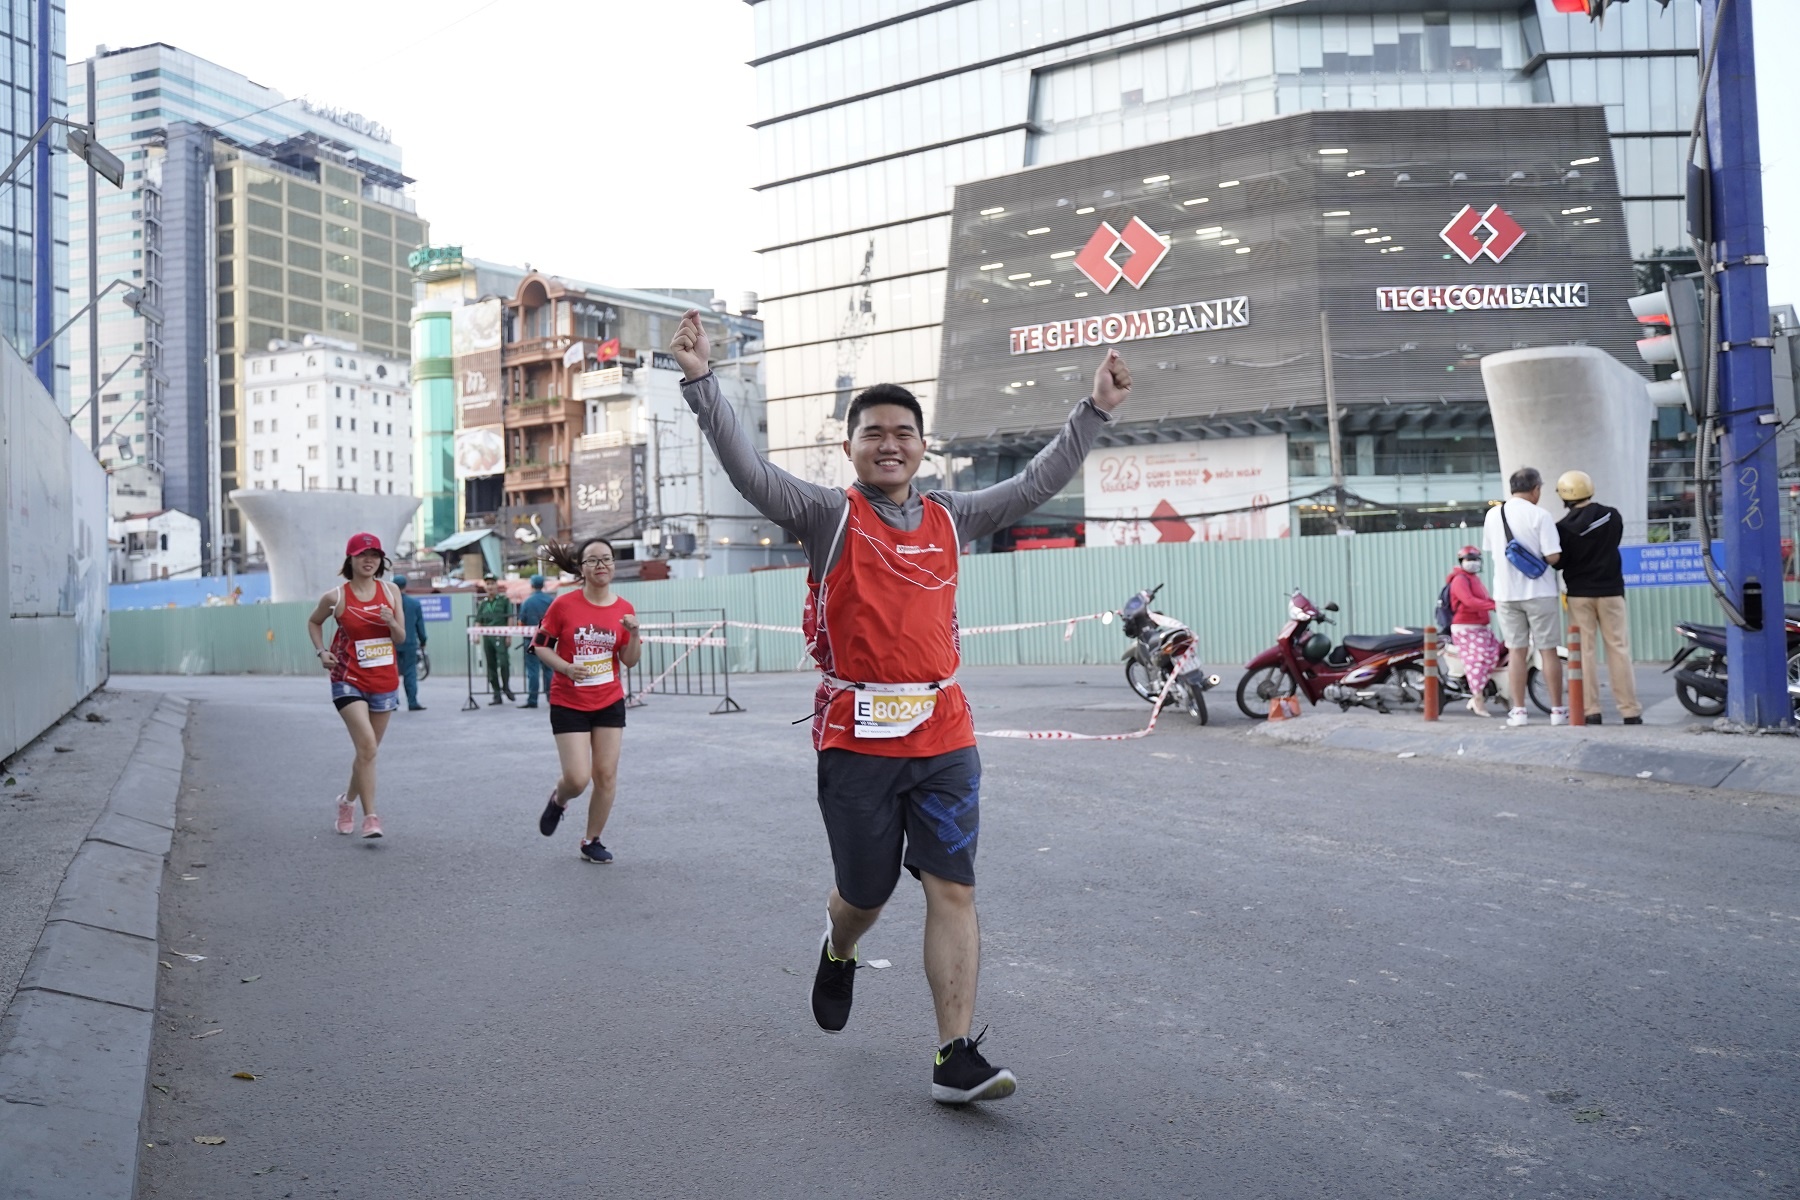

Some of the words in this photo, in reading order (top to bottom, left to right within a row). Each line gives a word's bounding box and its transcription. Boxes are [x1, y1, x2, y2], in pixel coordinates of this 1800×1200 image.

[1378, 283, 1588, 311] TECHCOMBANK
[1010, 296, 1249, 355] TECHCOMBANK
[1641, 573, 1656, 584] FOR
[1657, 572, 1674, 583] THIS
[357, 649, 366, 658] C
[366, 645, 393, 657] 64072
[858, 701, 871, 717] E
